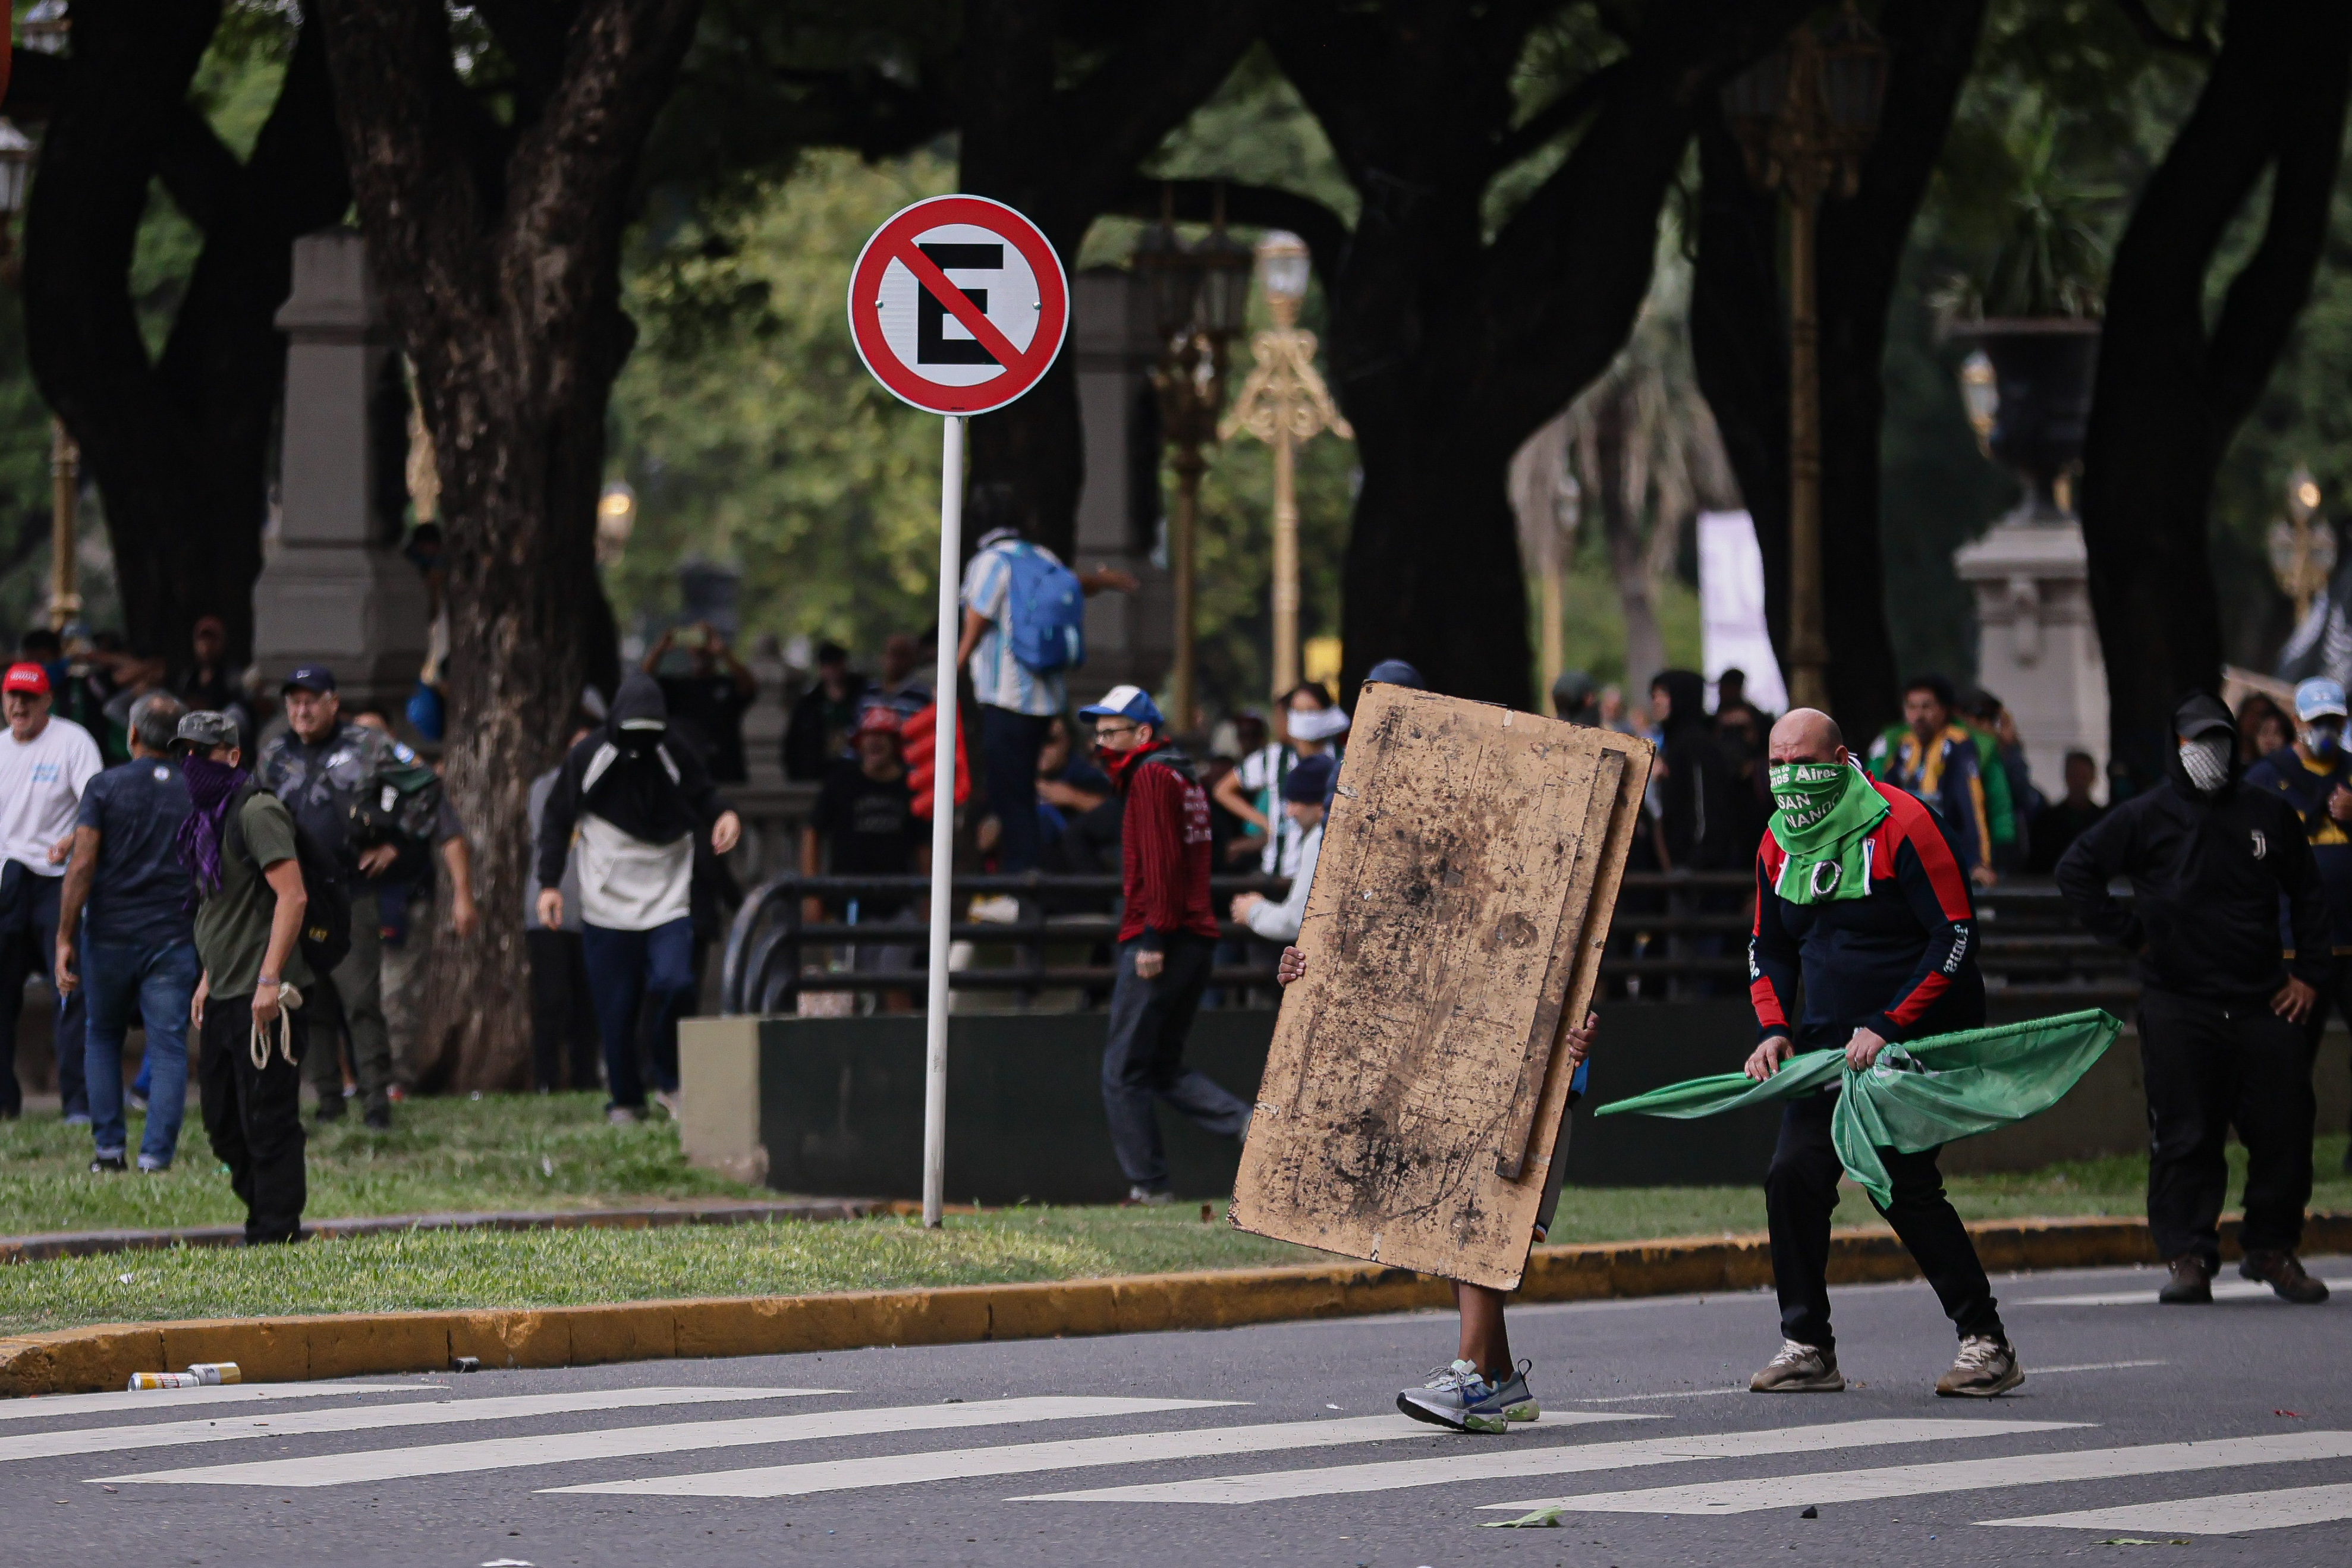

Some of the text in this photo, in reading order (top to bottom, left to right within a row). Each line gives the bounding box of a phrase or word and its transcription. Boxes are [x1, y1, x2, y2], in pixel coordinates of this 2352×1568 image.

[917, 243, 1004, 364] E
[1795, 765, 1837, 782] Aires
[1778, 792, 1811, 810] SAN
